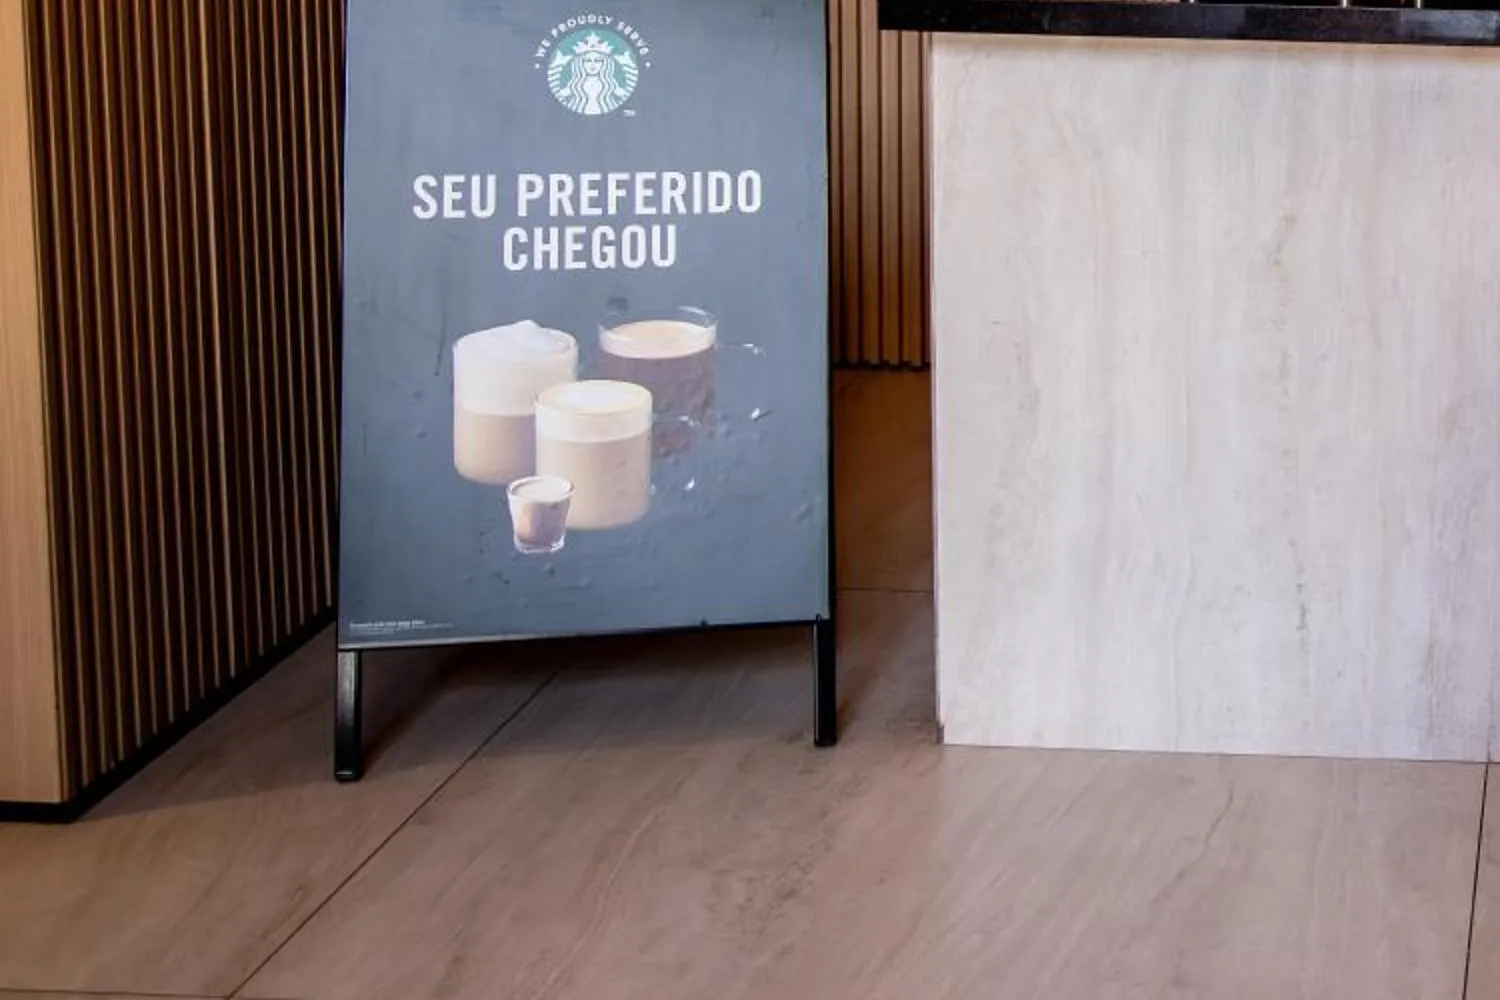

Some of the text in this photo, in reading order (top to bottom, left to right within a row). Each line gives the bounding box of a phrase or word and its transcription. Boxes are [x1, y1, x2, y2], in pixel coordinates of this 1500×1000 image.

[535, 14, 649, 58] WE PROUDLY SERVE
[412, 169, 762, 220] SEU PREFERIDO
[502, 223, 677, 272] CHEGOU
